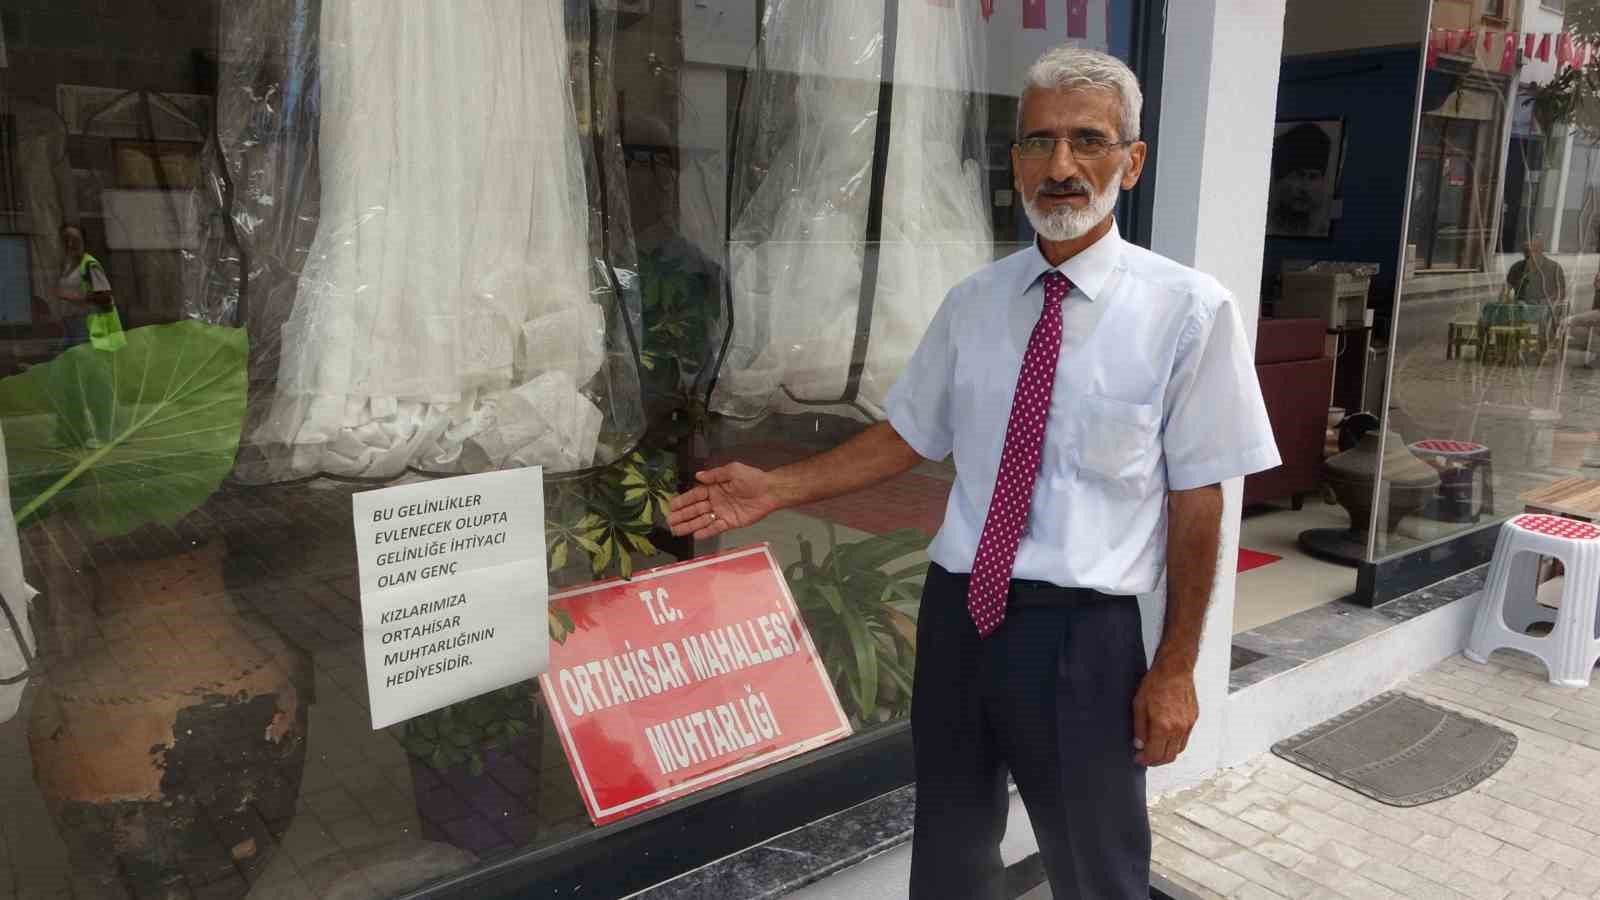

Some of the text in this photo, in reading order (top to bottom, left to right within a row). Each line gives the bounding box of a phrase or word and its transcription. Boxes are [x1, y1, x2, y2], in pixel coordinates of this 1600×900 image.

[373, 494, 481, 522] BU GELİNLİKLER
[375, 511, 508, 544] EVLENECEK OLUPTA
[376, 532, 506, 566] GELİNLİĞE İHTİYACI
[377, 561, 458, 588] OLAN GENÇ
[380, 593, 467, 625] KIZLARIMIZA
[640, 587, 684, 625] T.C.
[382, 615, 461, 644] ORTAHİSAR
[384, 627, 495, 666] MUHTARLIĞININ
[559, 600, 800, 717] ORTAHİSAR MAHALLESİ
[386, 655, 473, 688] HEDİYESİDİR.
[645, 683, 781, 775] MUHTARLIĞI
